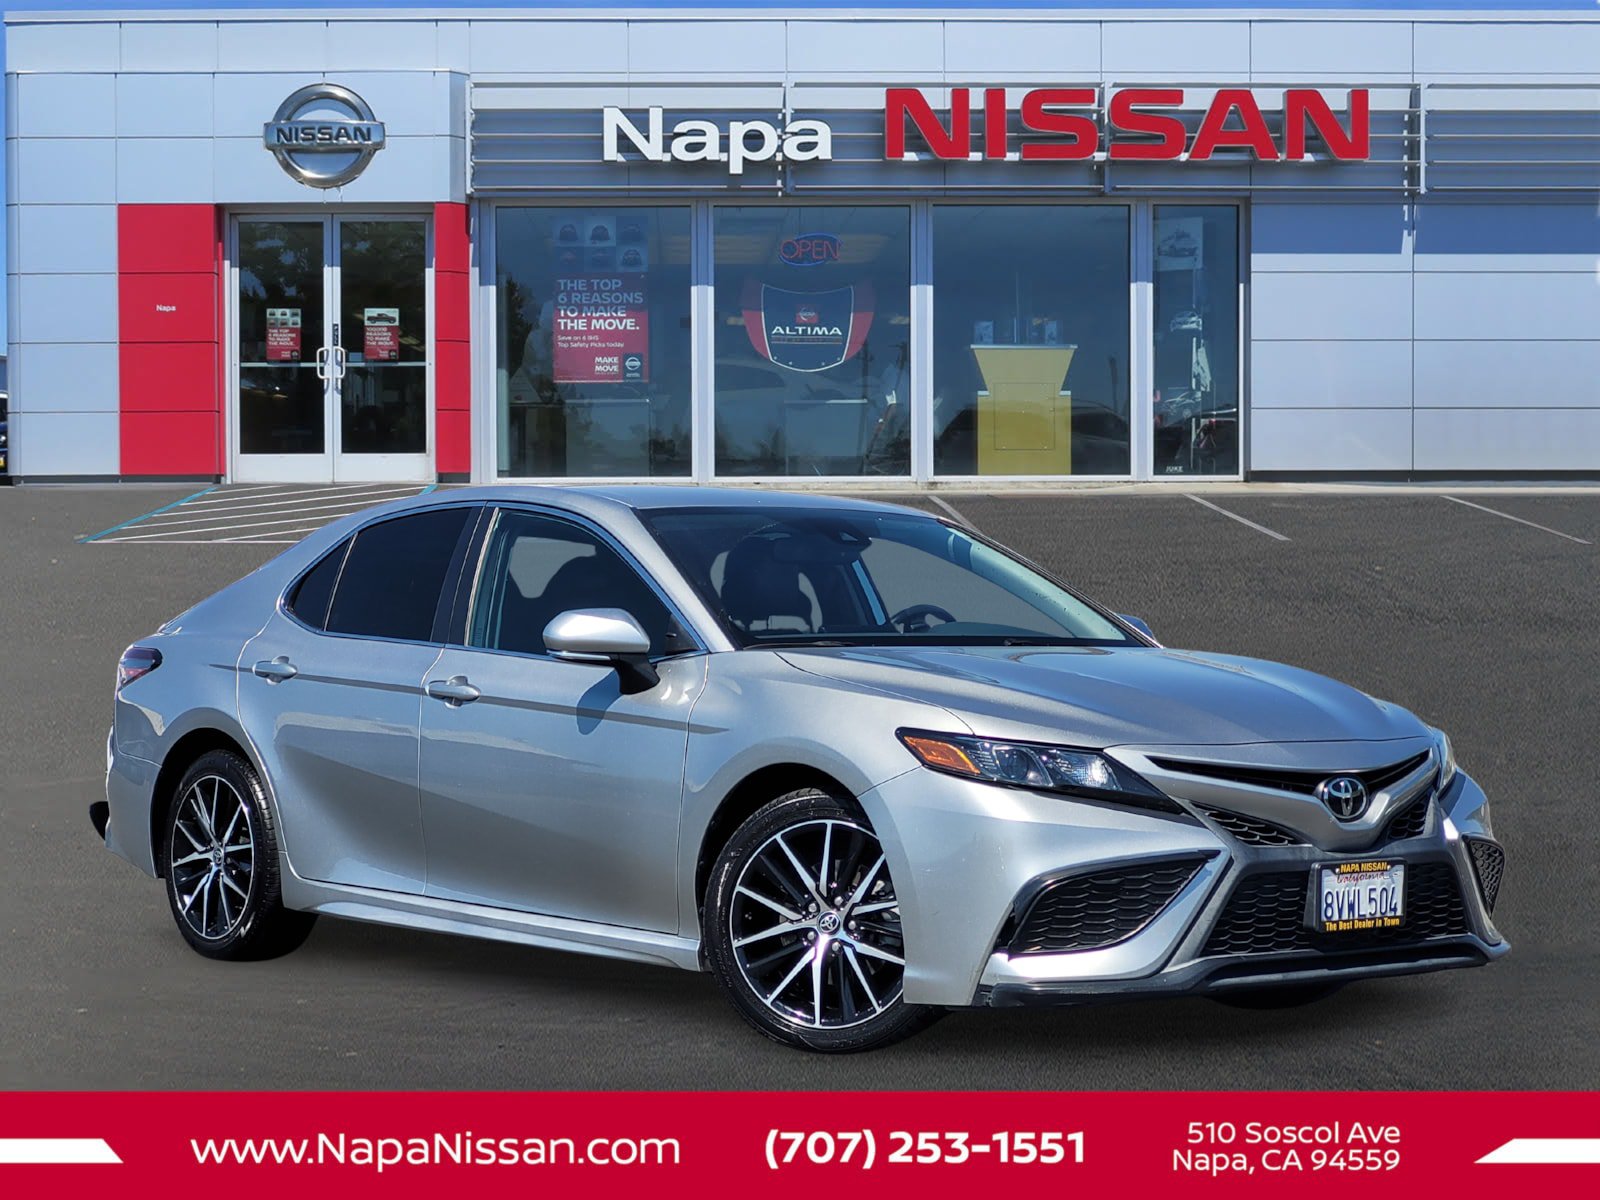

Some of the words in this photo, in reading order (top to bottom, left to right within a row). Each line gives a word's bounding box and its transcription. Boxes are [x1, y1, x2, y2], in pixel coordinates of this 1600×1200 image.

[276, 126, 371, 143] NISSAN
[602, 106, 832, 174] Napa
[884, 86, 1371, 162] NISSAN
[781, 239, 841, 260] OPEN
[558, 279, 587, 291] THE
[591, 279, 622, 291] TOP
[558, 292, 567, 304] 6
[571, 292, 644, 304] REASONS
[156, 304, 177, 312] Napa
[558, 305, 578, 317] TO
[582, 305, 626, 317] MAKE
[558, 319, 587, 330] THE
[591, 319, 640, 330] MOVE.
[771, 325, 843, 336] ALTIMA
[1165, 465, 1184, 473] JUKE
[1340, 863, 1360, 873] NAPA
[1361, 862, 1387, 872] NISSAN
[1324, 886, 1398, 920] 8VWL504
[1325, 921, 1337, 932] The
[1339, 920, 1353, 931] Best
[1354, 918, 1375, 929] Dealer
[1375, 918, 1383, 928] in
[1384, 917, 1400, 926] Town
